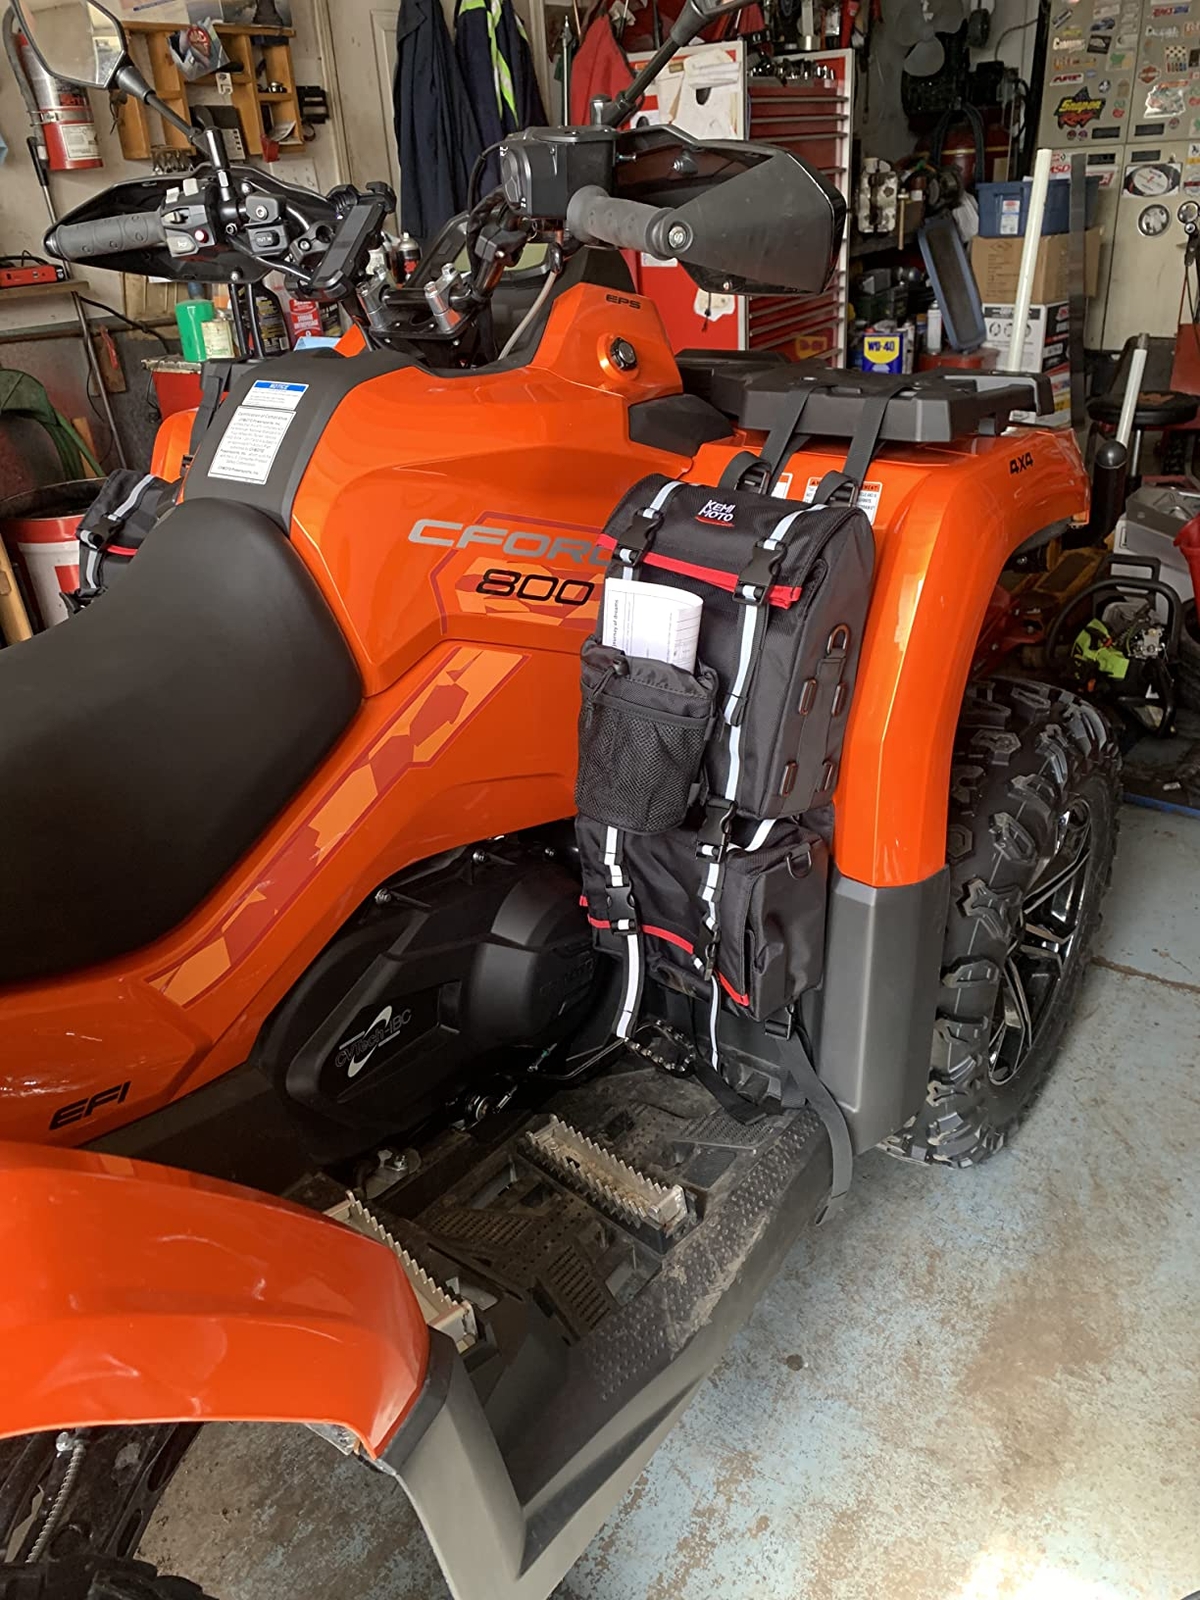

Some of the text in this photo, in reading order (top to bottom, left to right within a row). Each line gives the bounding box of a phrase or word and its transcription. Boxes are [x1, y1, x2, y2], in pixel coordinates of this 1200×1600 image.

[606, 294, 641, 309] EPS
[868, 341, 895, 352] WD-40
[704, 500, 736, 513] KEMI
[698, 508, 734, 522] MOTO
[476, 569, 595, 606] 800
[49, 1081, 132, 1130] EFI
